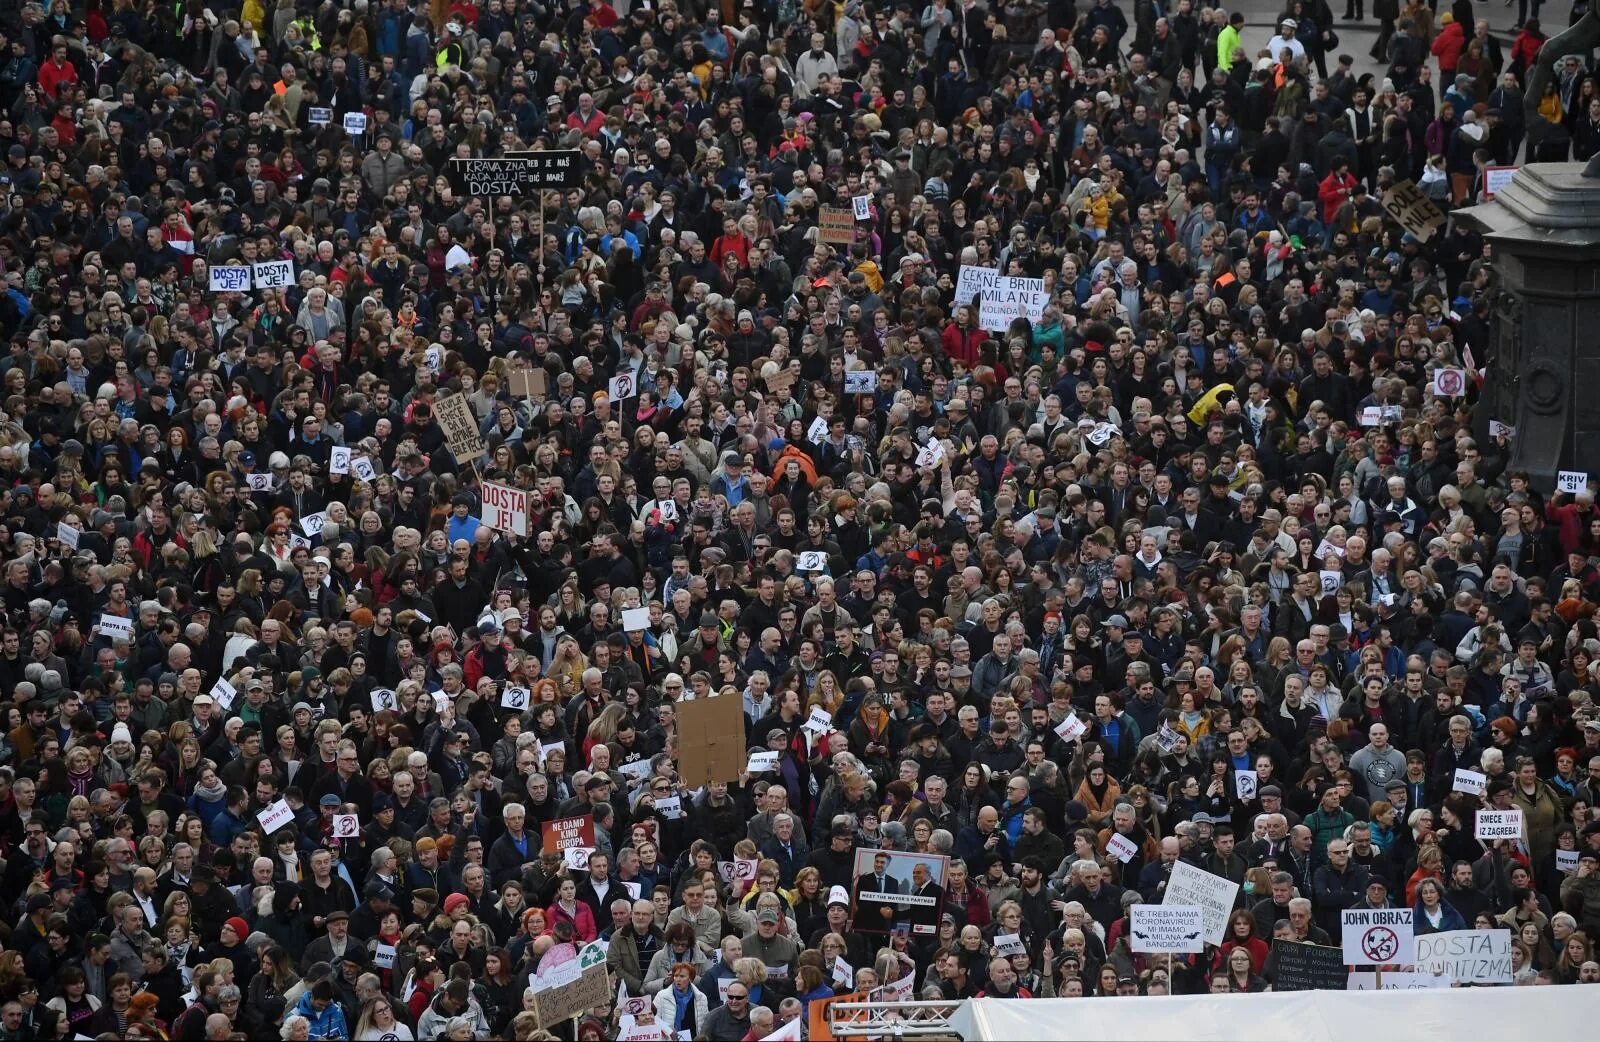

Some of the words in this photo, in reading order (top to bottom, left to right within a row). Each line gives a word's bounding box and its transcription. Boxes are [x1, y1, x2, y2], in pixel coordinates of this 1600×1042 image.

[466, 160, 503, 173] KRAVA
[506, 161, 527, 172] ZNA
[545, 160, 553, 168] JE
[557, 156, 570, 168] NAŠ
[463, 172, 493, 182] KADA
[511, 171, 528, 182] JE
[470, 181, 522, 196] DOSTA
[1403, 203, 1441, 236] MILE
[213, 268, 249, 280] DOSTA
[257, 264, 290, 278] DOSTA
[220, 278, 243, 290] JE!
[265, 273, 287, 286] JE!
[983, 276, 1001, 289] NE
[1009, 277, 1043, 292] BRINI
[981, 289, 1040, 305] MILANE
[982, 305, 1018, 316] KOLINDA
[1559, 475, 1585, 483] KRIV
[1567, 483, 1577, 491] SI
[482, 484, 526, 514] DOSTA
[494, 510, 513, 531] JE!
[101, 622, 120, 631] DOSTA
[811, 715, 828, 727] DOSTA
[1456, 777, 1476, 786] DOSTA
[656, 804, 672, 814] OSTA
[262, 812, 280, 827] DOSTA
[552, 822, 564, 832] NE
[564, 818, 585, 831] DAMO
[1505, 815, 1519, 824] VAN
[561, 829, 579, 840] KINO
[1480, 826, 1489, 836] IZ
[557, 837, 585, 850] EUROPA
[1134, 910, 1145, 918] NE
[1147, 910, 1174, 918] TREBA
[1175, 910, 1199, 919] NAMA
[1343, 911, 1370, 926] JOHN
[1372, 910, 1413, 925] OBRAZ
[1151, 933, 1181, 941] MILANA
[1417, 935, 1493, 962] DOSTA
[377, 952, 394, 961] DOST
